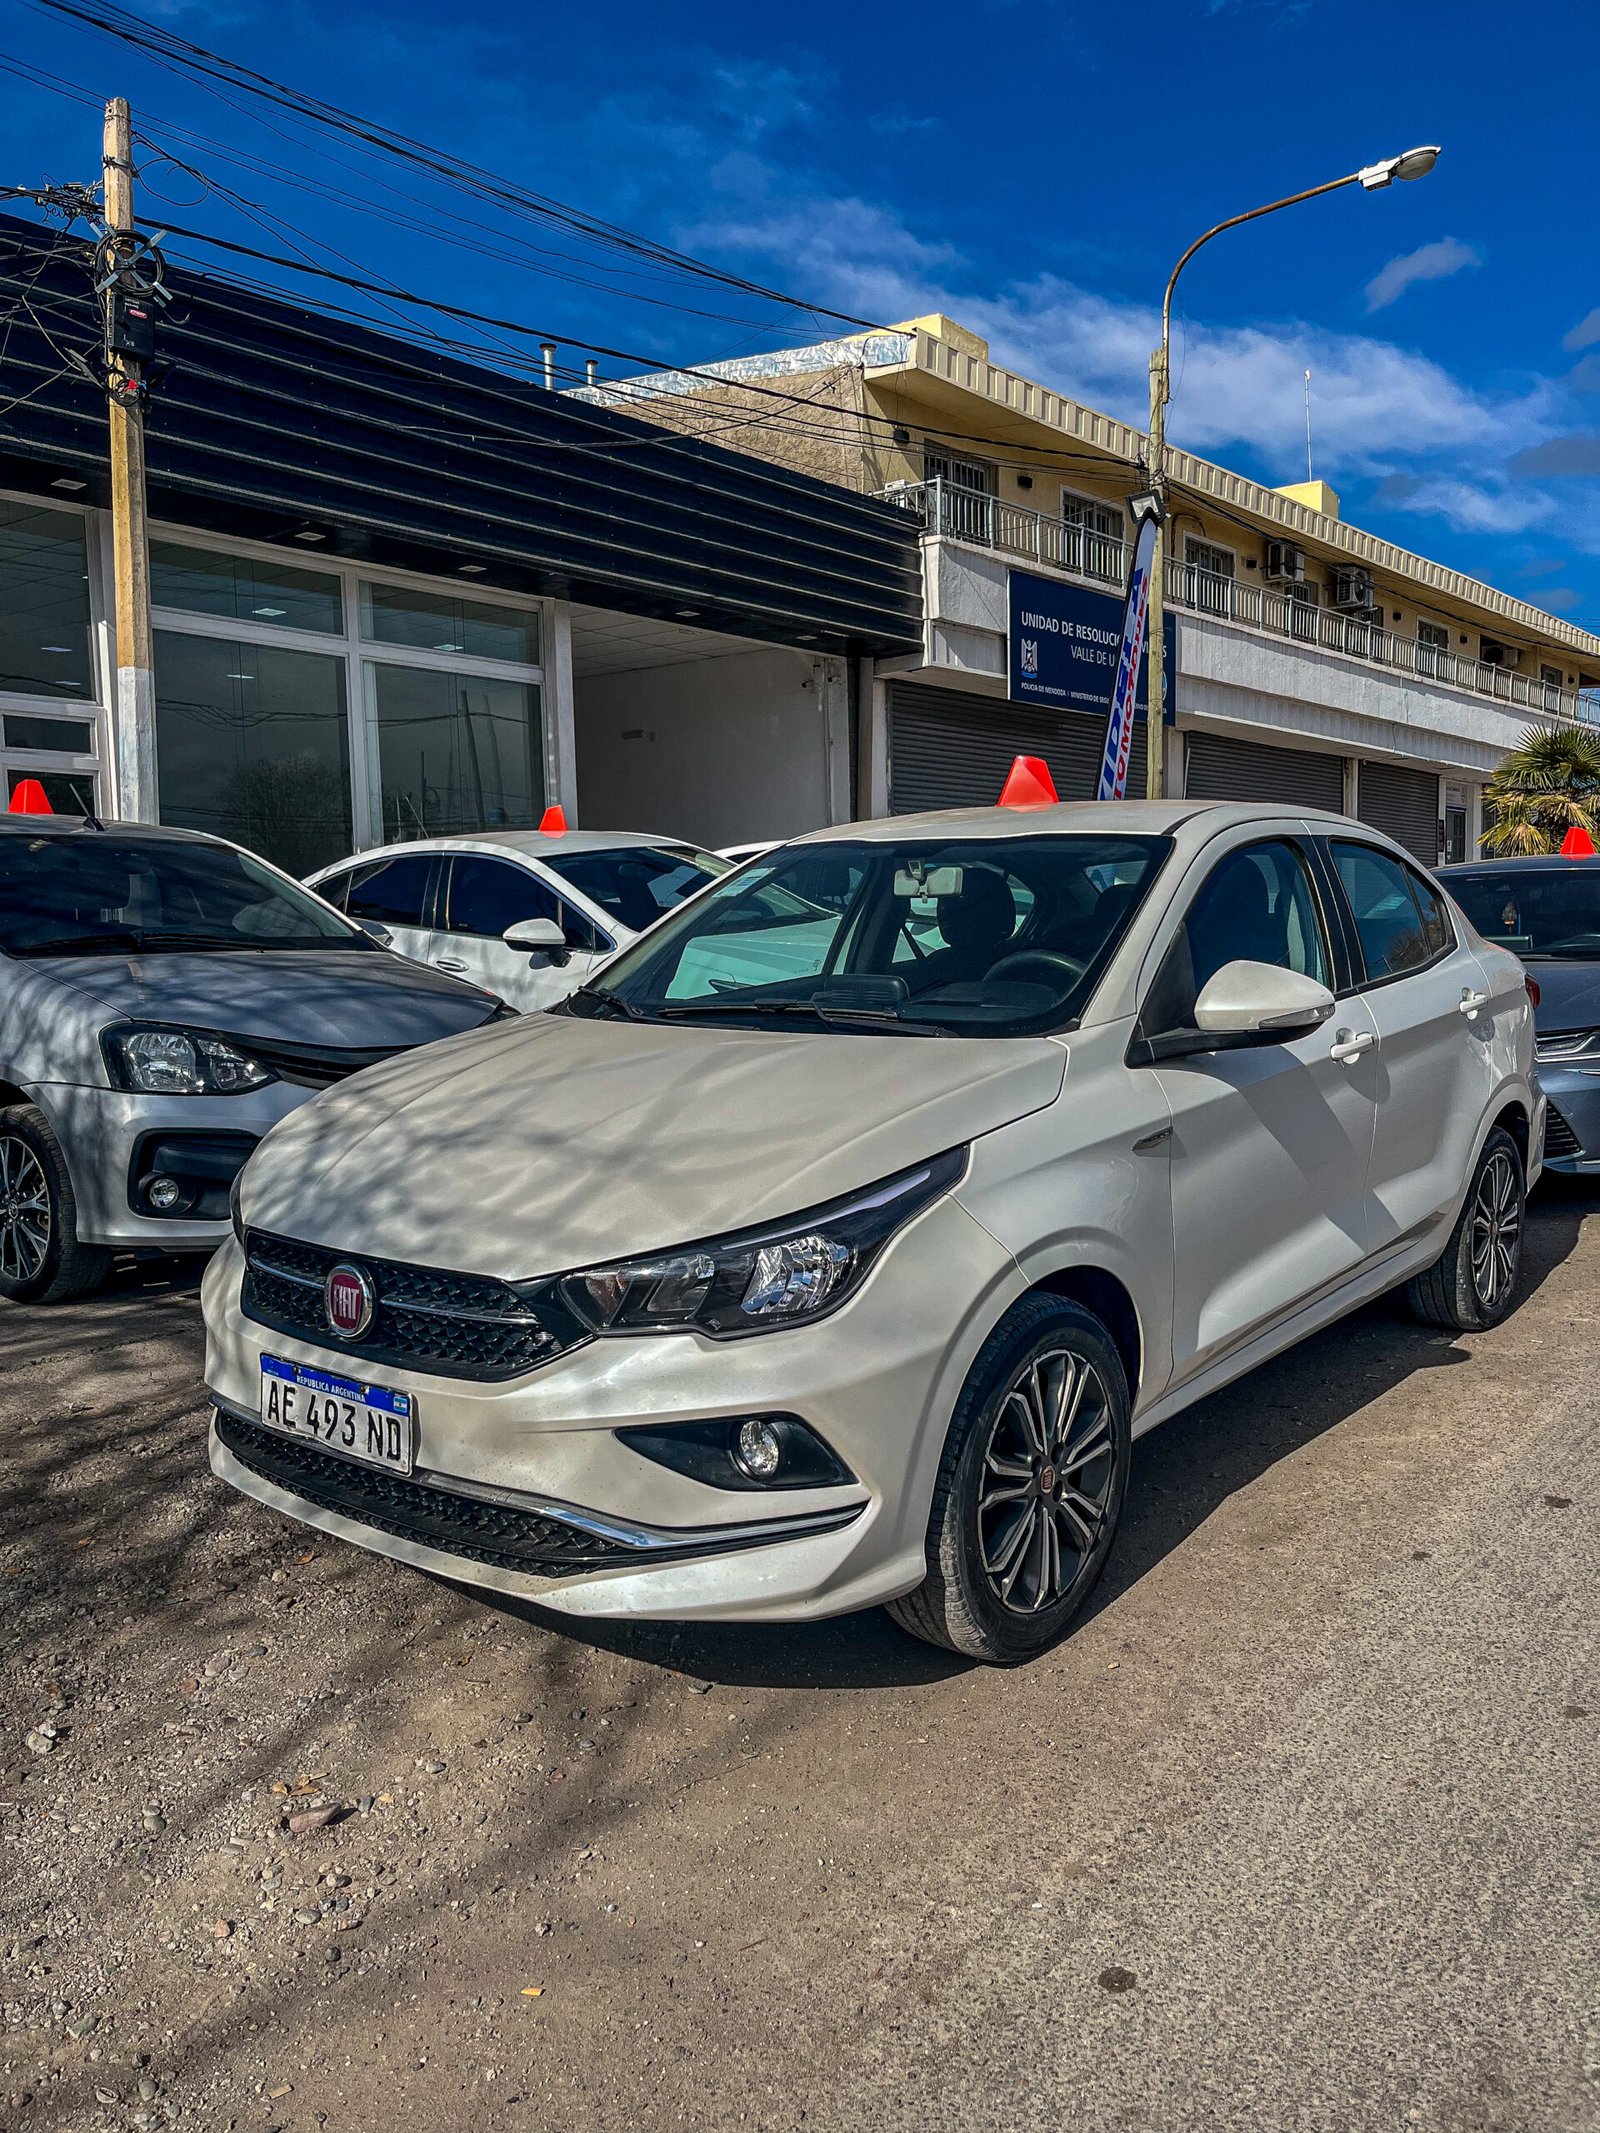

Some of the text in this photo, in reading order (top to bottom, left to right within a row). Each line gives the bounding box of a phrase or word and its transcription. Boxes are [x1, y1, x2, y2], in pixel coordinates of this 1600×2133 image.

[1021, 611, 1059, 633] UNIDAD
[1061, 621, 1074, 637] DE
[1070, 645, 1095, 663] VALLE
[1096, 651, 1107, 665] DE
[333, 1284, 360, 1320] FIAT
[296, 1375, 366, 1404] REPUBLICA ARGENTINA
[267, 1380, 401, 1461] AE 493 ND
